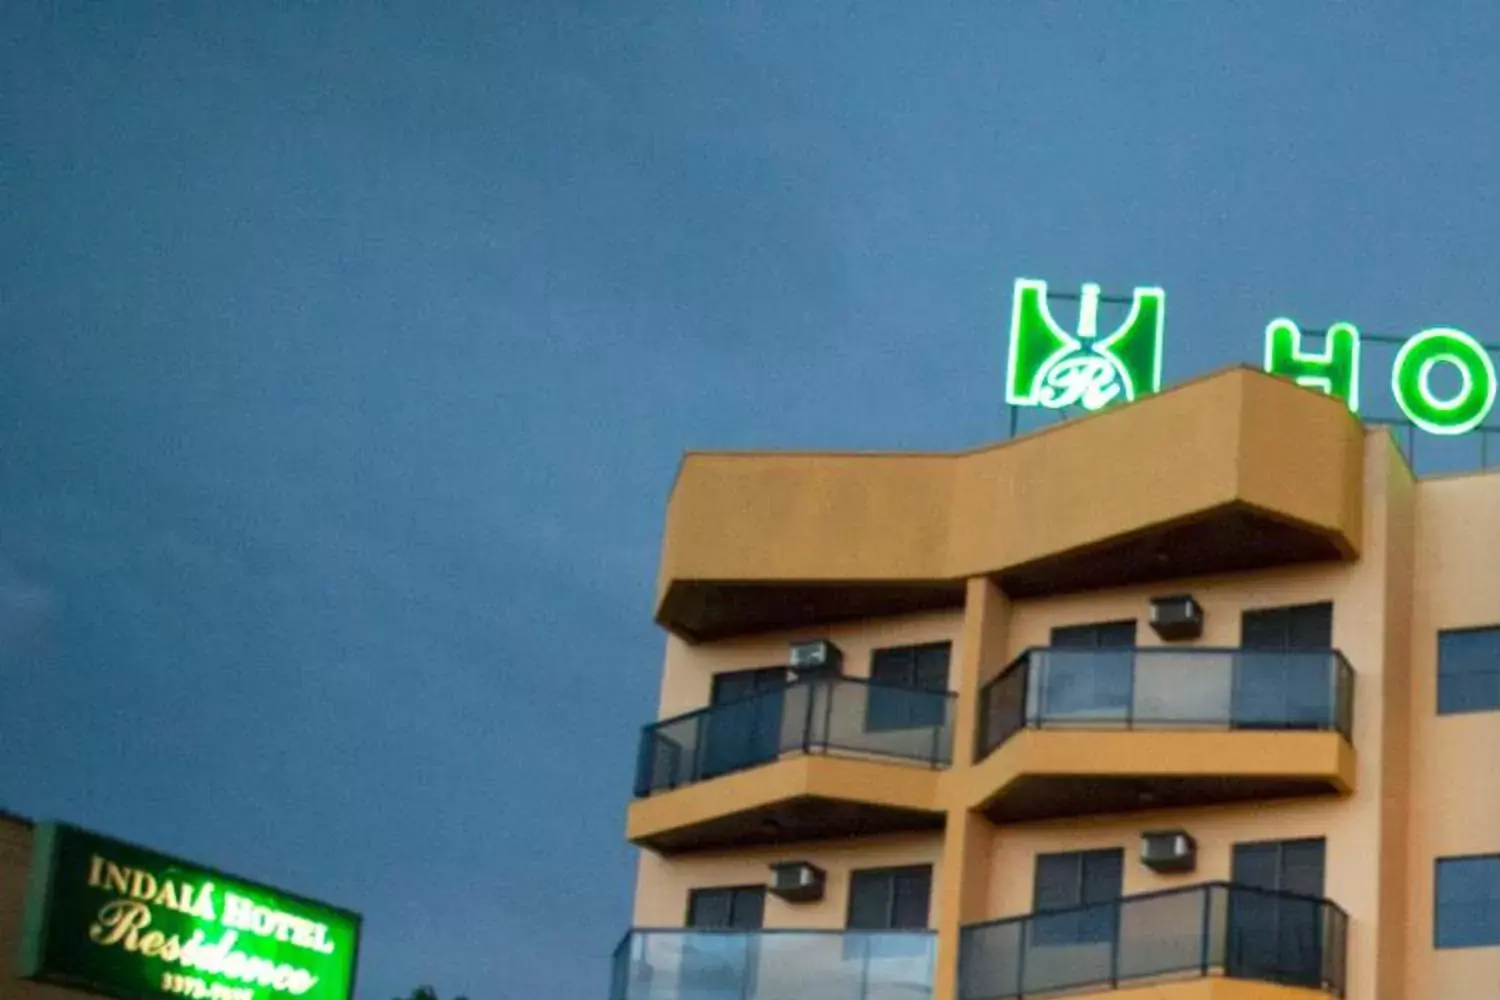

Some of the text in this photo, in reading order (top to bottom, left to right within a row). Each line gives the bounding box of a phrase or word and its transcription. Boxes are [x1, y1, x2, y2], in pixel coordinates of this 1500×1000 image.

[88, 854, 335, 955] INDAIÁ HOTEL
[89, 900, 320, 995] Residence
